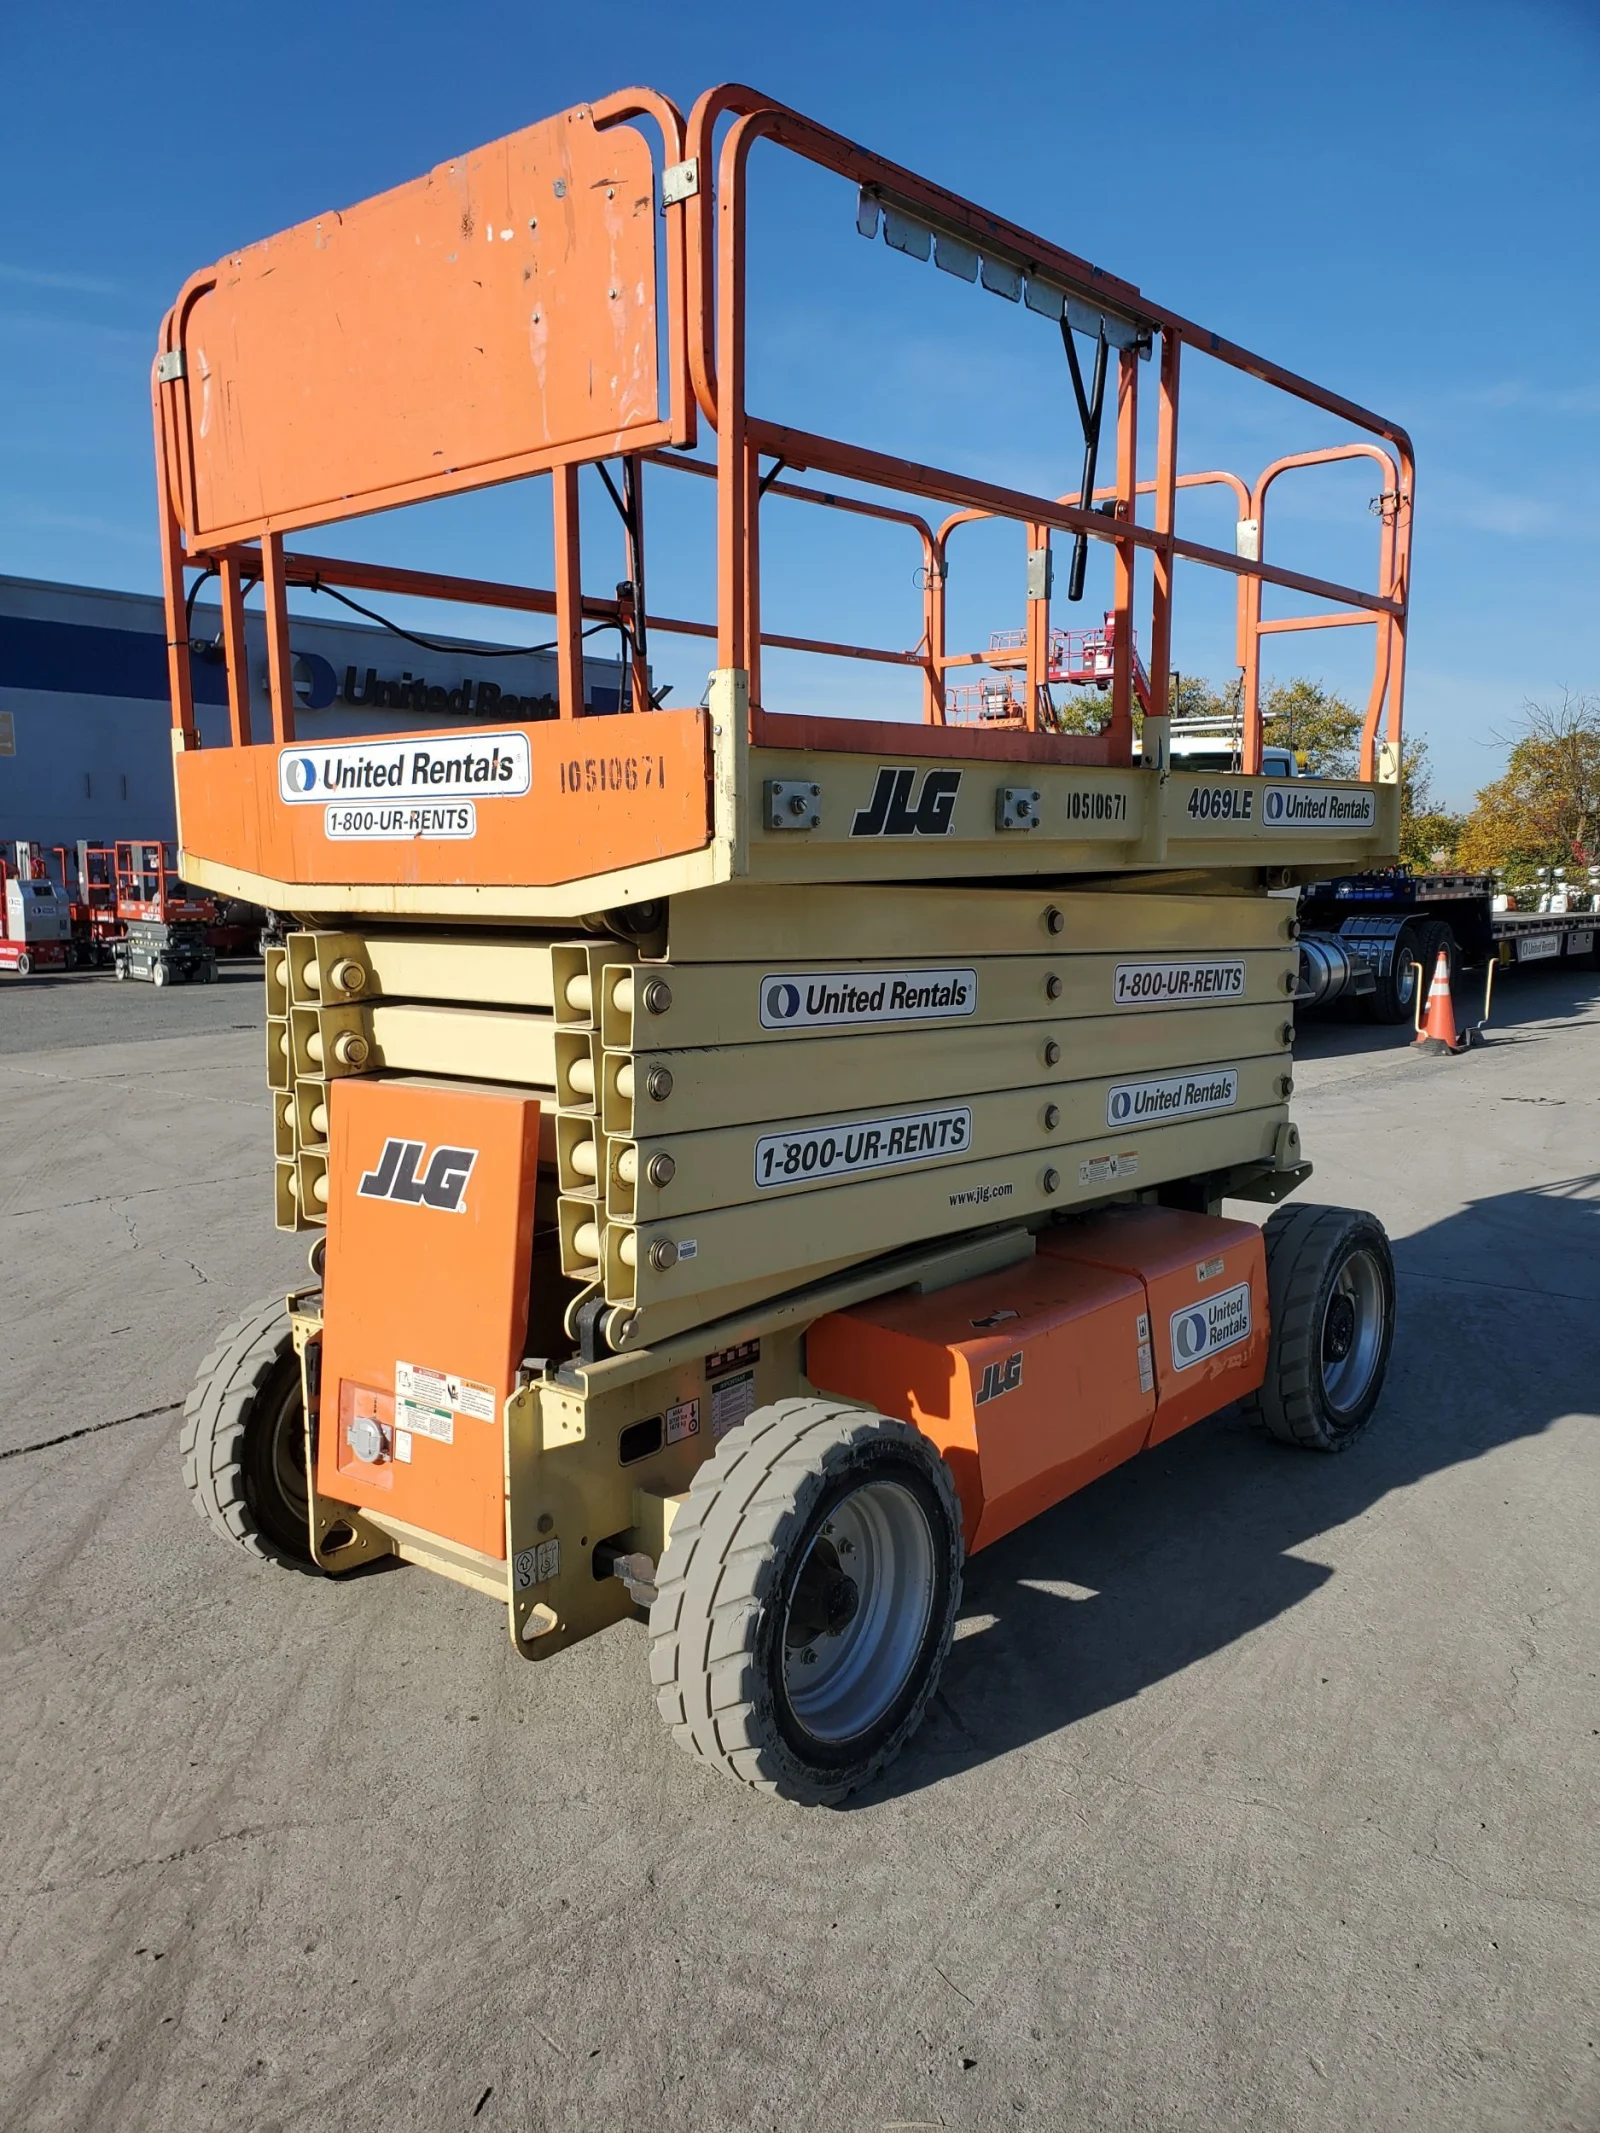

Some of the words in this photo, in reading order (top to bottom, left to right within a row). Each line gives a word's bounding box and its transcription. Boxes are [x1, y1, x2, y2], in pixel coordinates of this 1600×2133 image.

[344, 666, 472, 716] United
[323, 754, 405, 790] United
[411, 747, 514, 785] Rentals
[559, 754, 665, 794] 10510671
[330, 808, 469, 832] 1-800-UR-RENTS
[850, 767, 963, 837] JLG
[1066, 792, 1127, 821] 10510671
[1188, 787, 1253, 819] 4069LE
[1285, 793, 1328, 819] United
[1328, 795, 1371, 820] Rentals
[805, 982, 886, 1015] United
[889, 979, 968, 1009] Rentals
[1118, 967, 1242, 997] 1-800-UR-RENTS
[1133, 1085, 1182, 1115] United
[1184, 1077, 1232, 1105] Rentals
[762, 1116, 966, 1178] 1-800-UR-RENTS
[358, 1139, 477, 1211] JLG
[949, 1182, 1013, 1207] www.jlg.com
[1208, 1293, 1244, 1326] United
[1209, 1314, 1248, 1346] Rentals
[975, 1350, 1023, 1407] JLG
